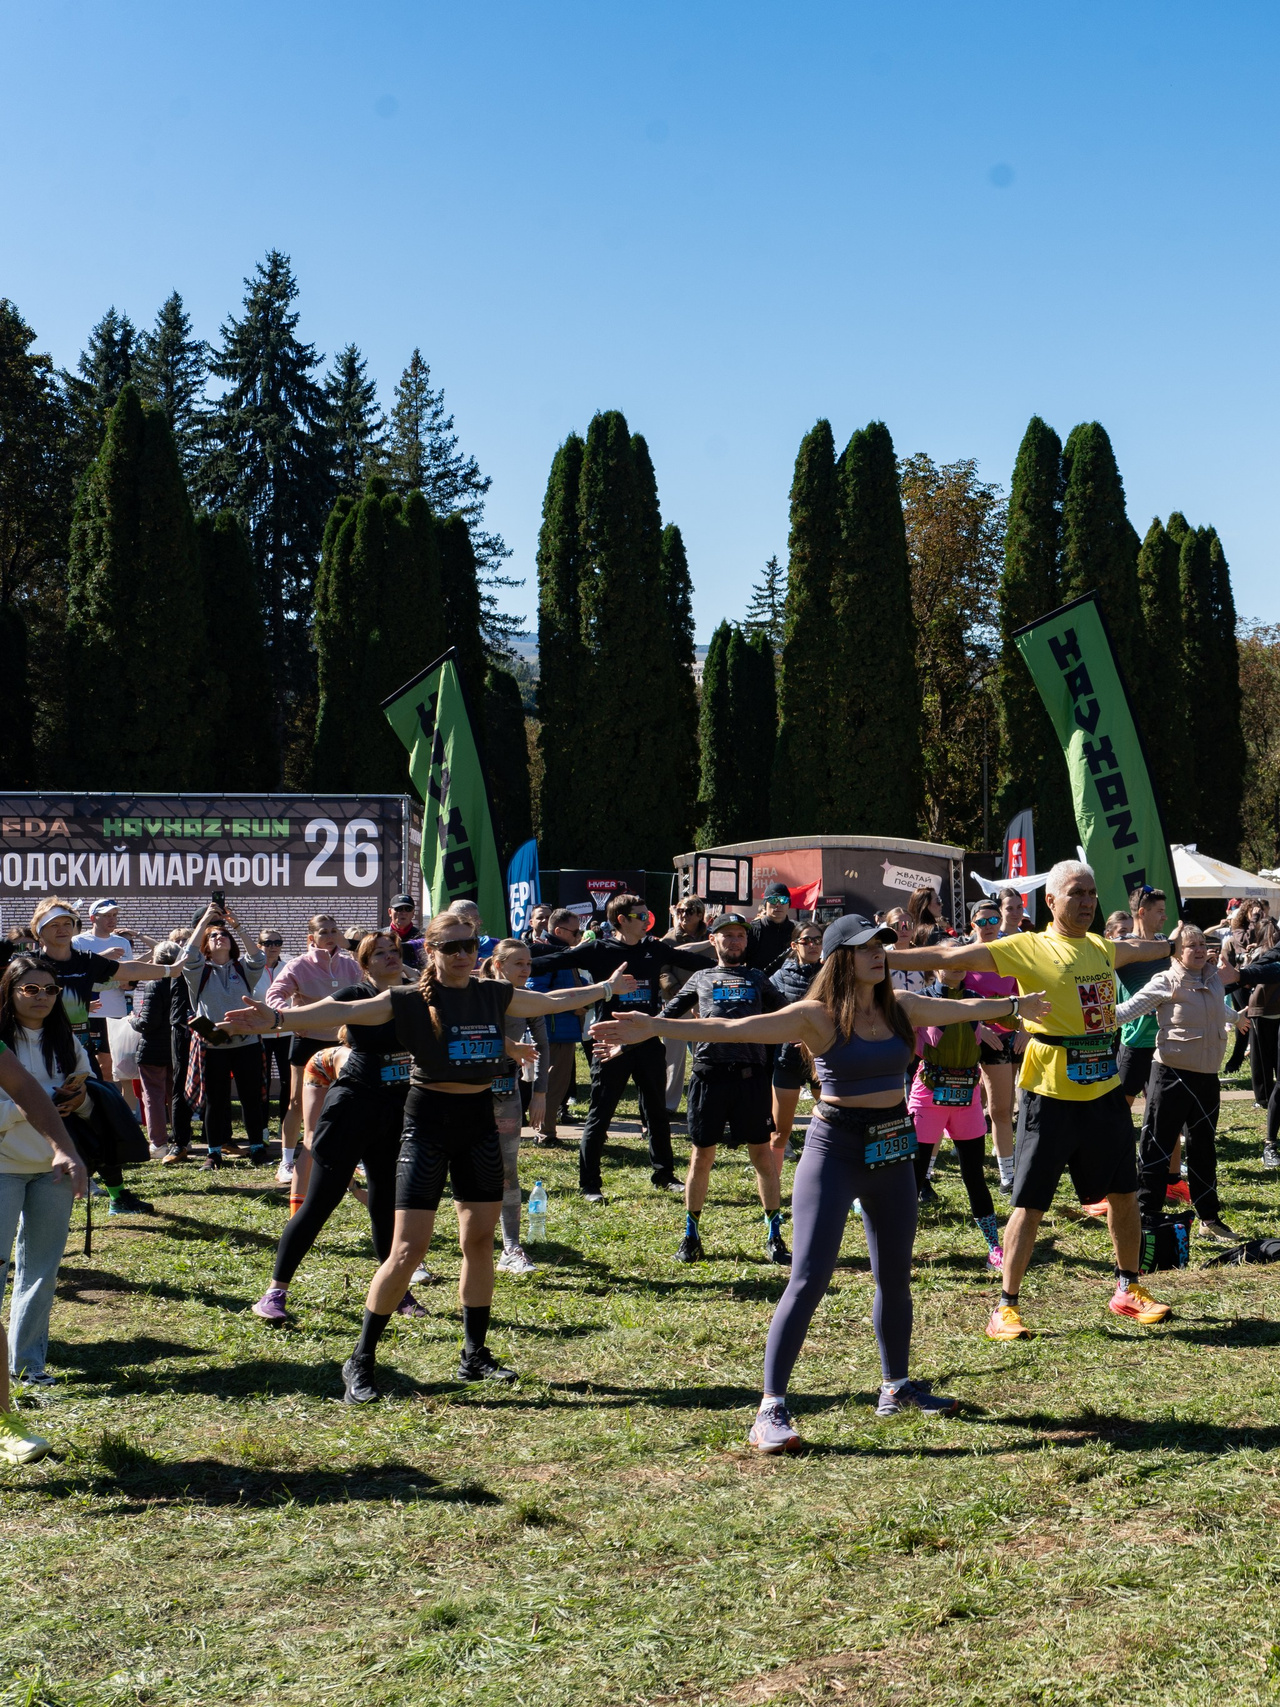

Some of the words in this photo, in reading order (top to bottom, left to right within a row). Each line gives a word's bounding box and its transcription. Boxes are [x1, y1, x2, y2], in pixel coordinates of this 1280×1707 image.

[304, 818, 379, 888] 26
[0, 845, 130, 891] ОДСКИЙ
[140, 853, 290, 887] МАРАФОН
[1074, 972, 1112, 984] МАРАФОН
[721, 989, 748, 997] 1292
[460, 1041, 494, 1055] 1277
[1077, 1062, 1109, 1076] 1519
[942, 1089, 969, 1099] 1189
[875, 1136, 909, 1158] 1298
